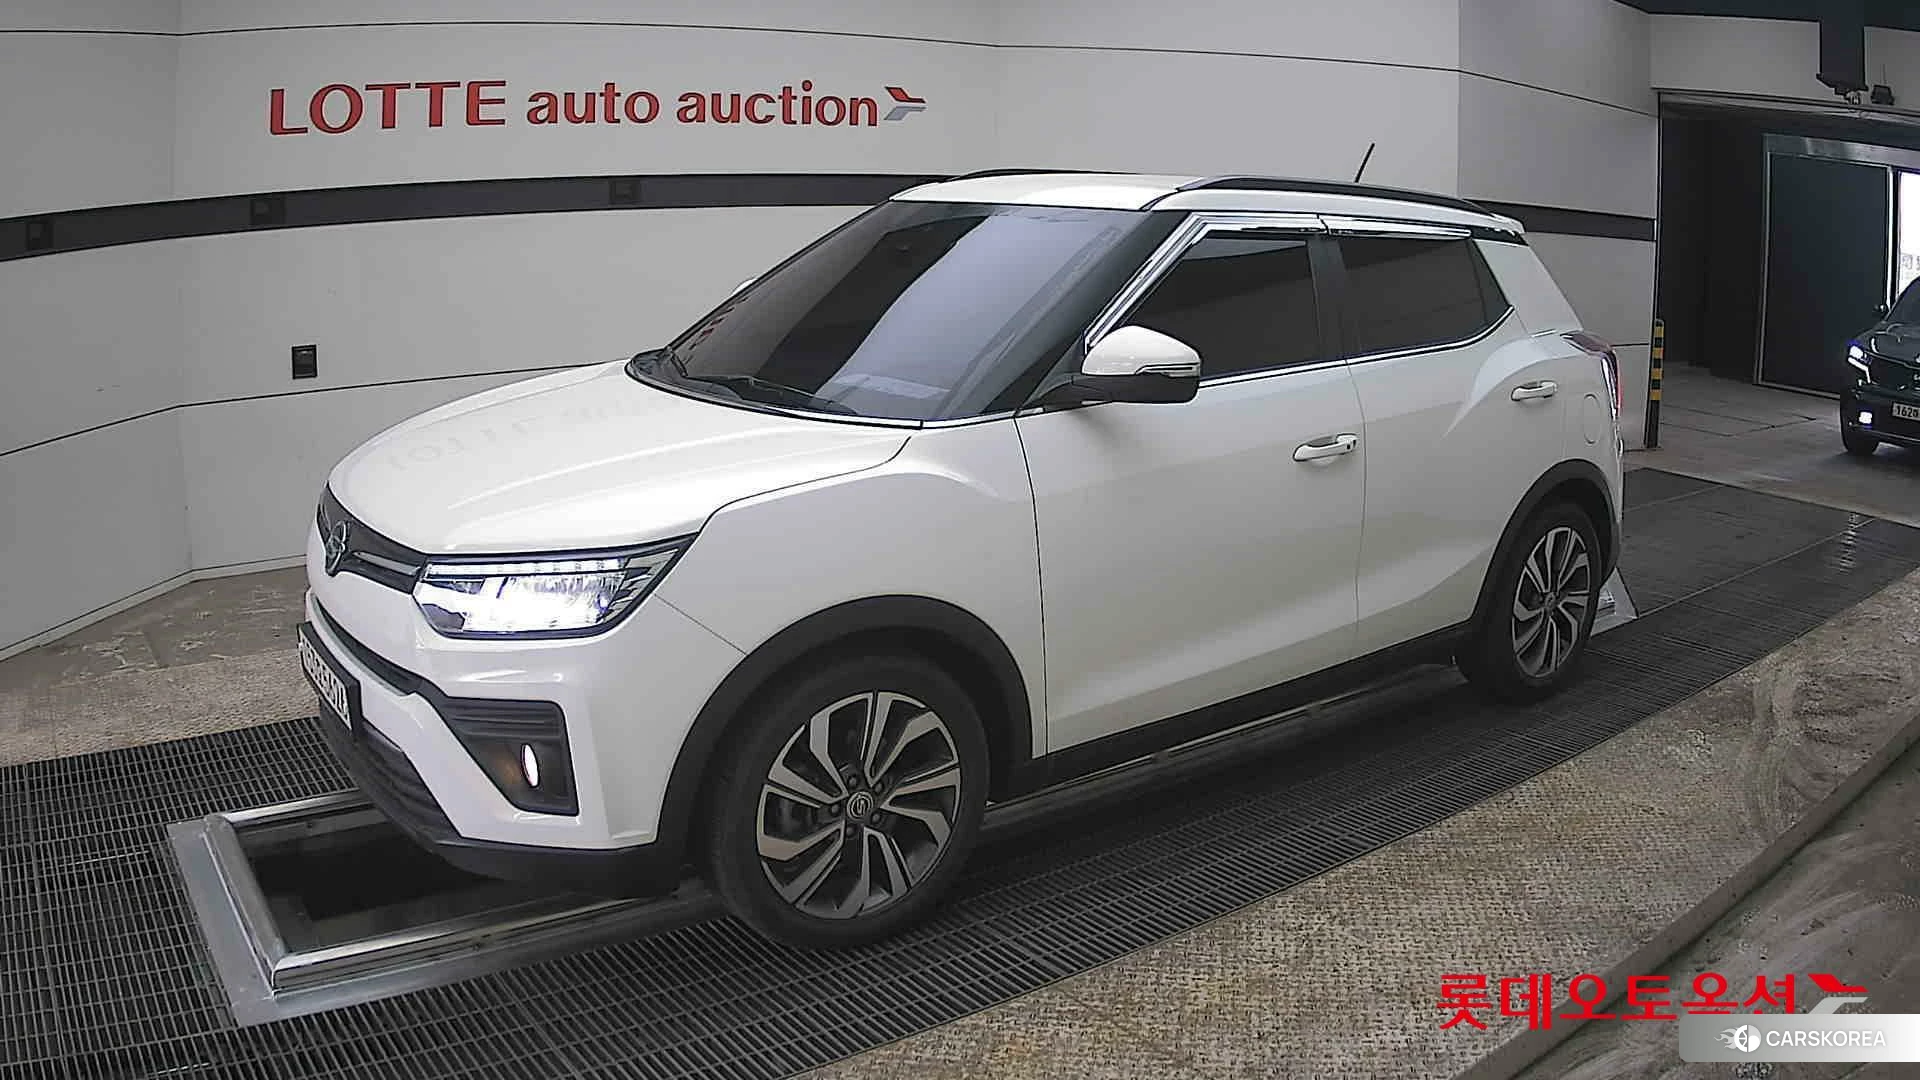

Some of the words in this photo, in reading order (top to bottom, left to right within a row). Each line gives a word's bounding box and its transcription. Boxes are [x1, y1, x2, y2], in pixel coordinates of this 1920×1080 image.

[269, 80, 506, 135] LOTTE
[526, 82, 660, 125] auto
[676, 80, 878, 127] auction
